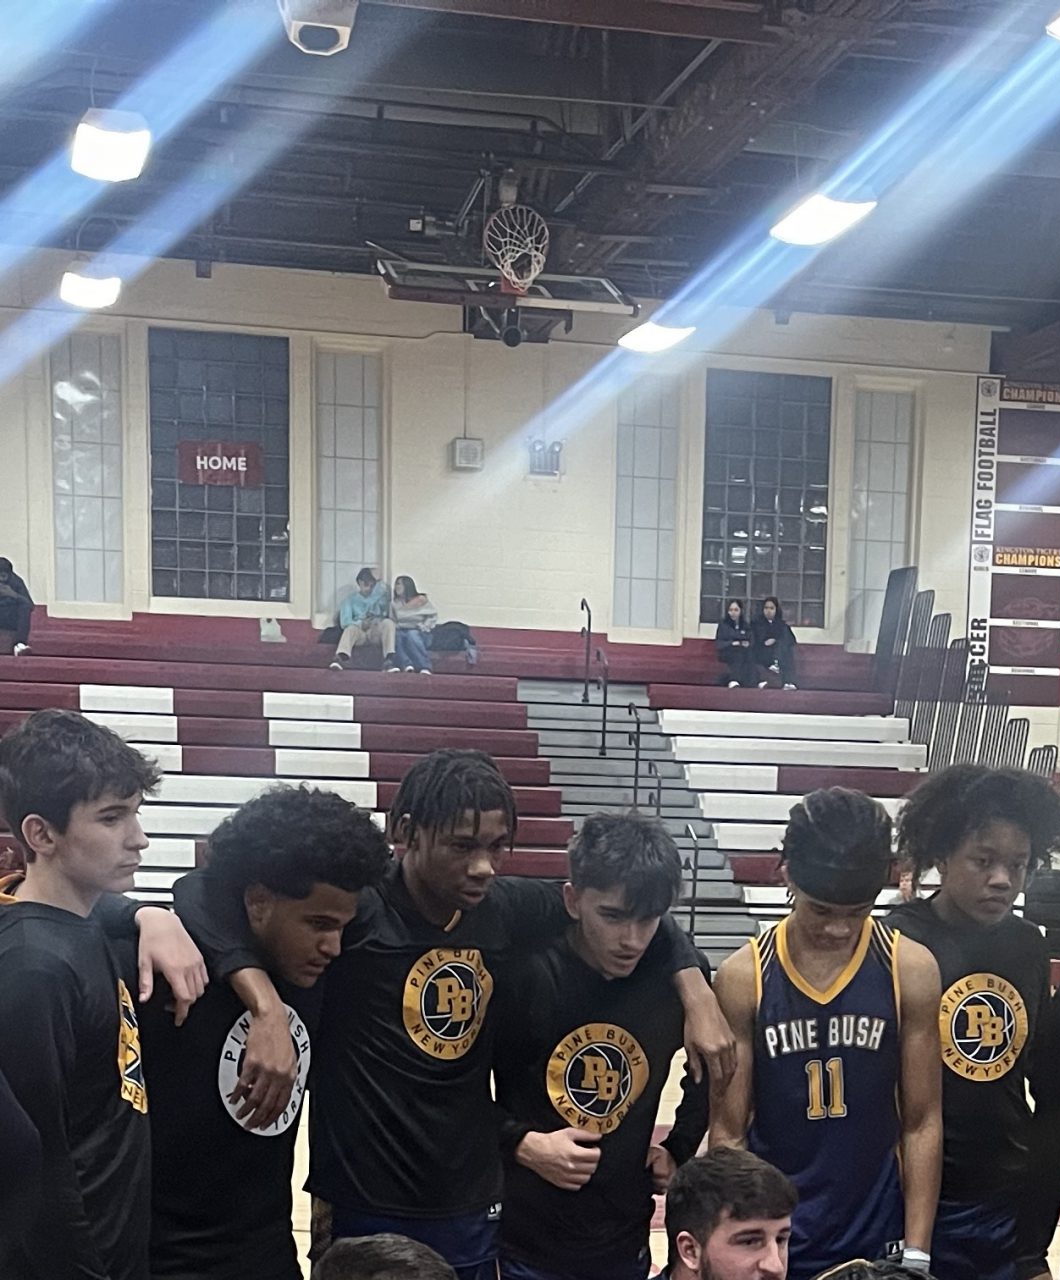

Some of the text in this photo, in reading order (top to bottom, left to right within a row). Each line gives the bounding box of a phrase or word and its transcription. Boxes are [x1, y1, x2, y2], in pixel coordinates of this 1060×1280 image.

[196, 455, 248, 471] HOME
[974, 408, 998, 538] FLAG FOOTBALL
[411, 951, 445, 988] PINE
[942, 978, 1022, 1014] PINE BUSH
[224, 1017, 250, 1062] PIN
[411, 1023, 445, 1053] NEW
[557, 1029, 642, 1066] PINE BUSH
[765, 1015, 886, 1058] PINE BUSH
[944, 1045, 1020, 1078] NEW YORK
[805, 1057, 847, 1120] 11
[556, 1095, 590, 1127] NEW
